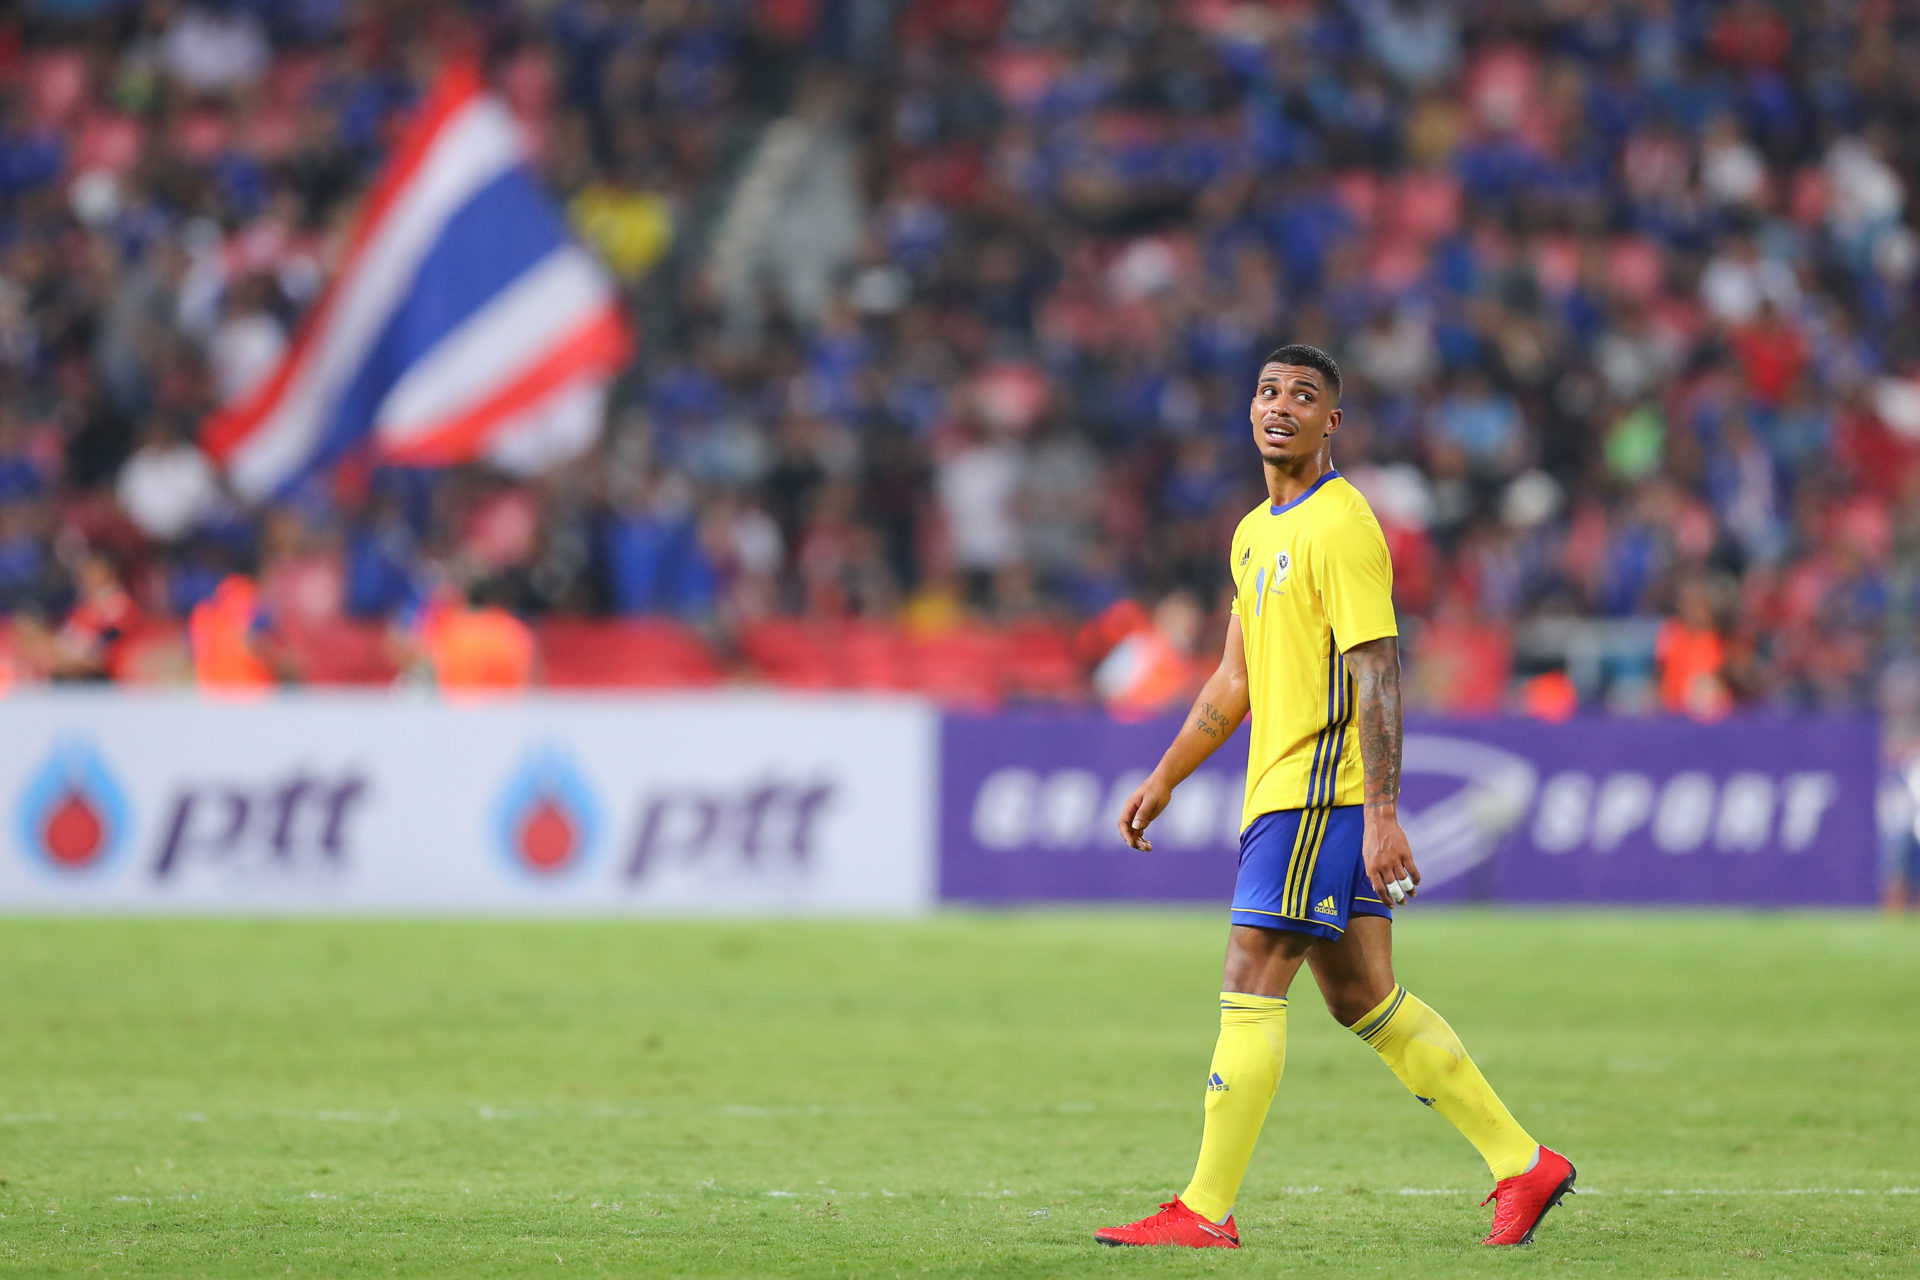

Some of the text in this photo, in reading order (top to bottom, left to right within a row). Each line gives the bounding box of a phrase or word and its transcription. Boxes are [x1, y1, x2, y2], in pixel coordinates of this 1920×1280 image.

[149, 768, 369, 882] ptt
[620, 769, 840, 884] ptt
[1532, 770, 1838, 854] SPORT
[1314, 906, 1338, 916] adidas
